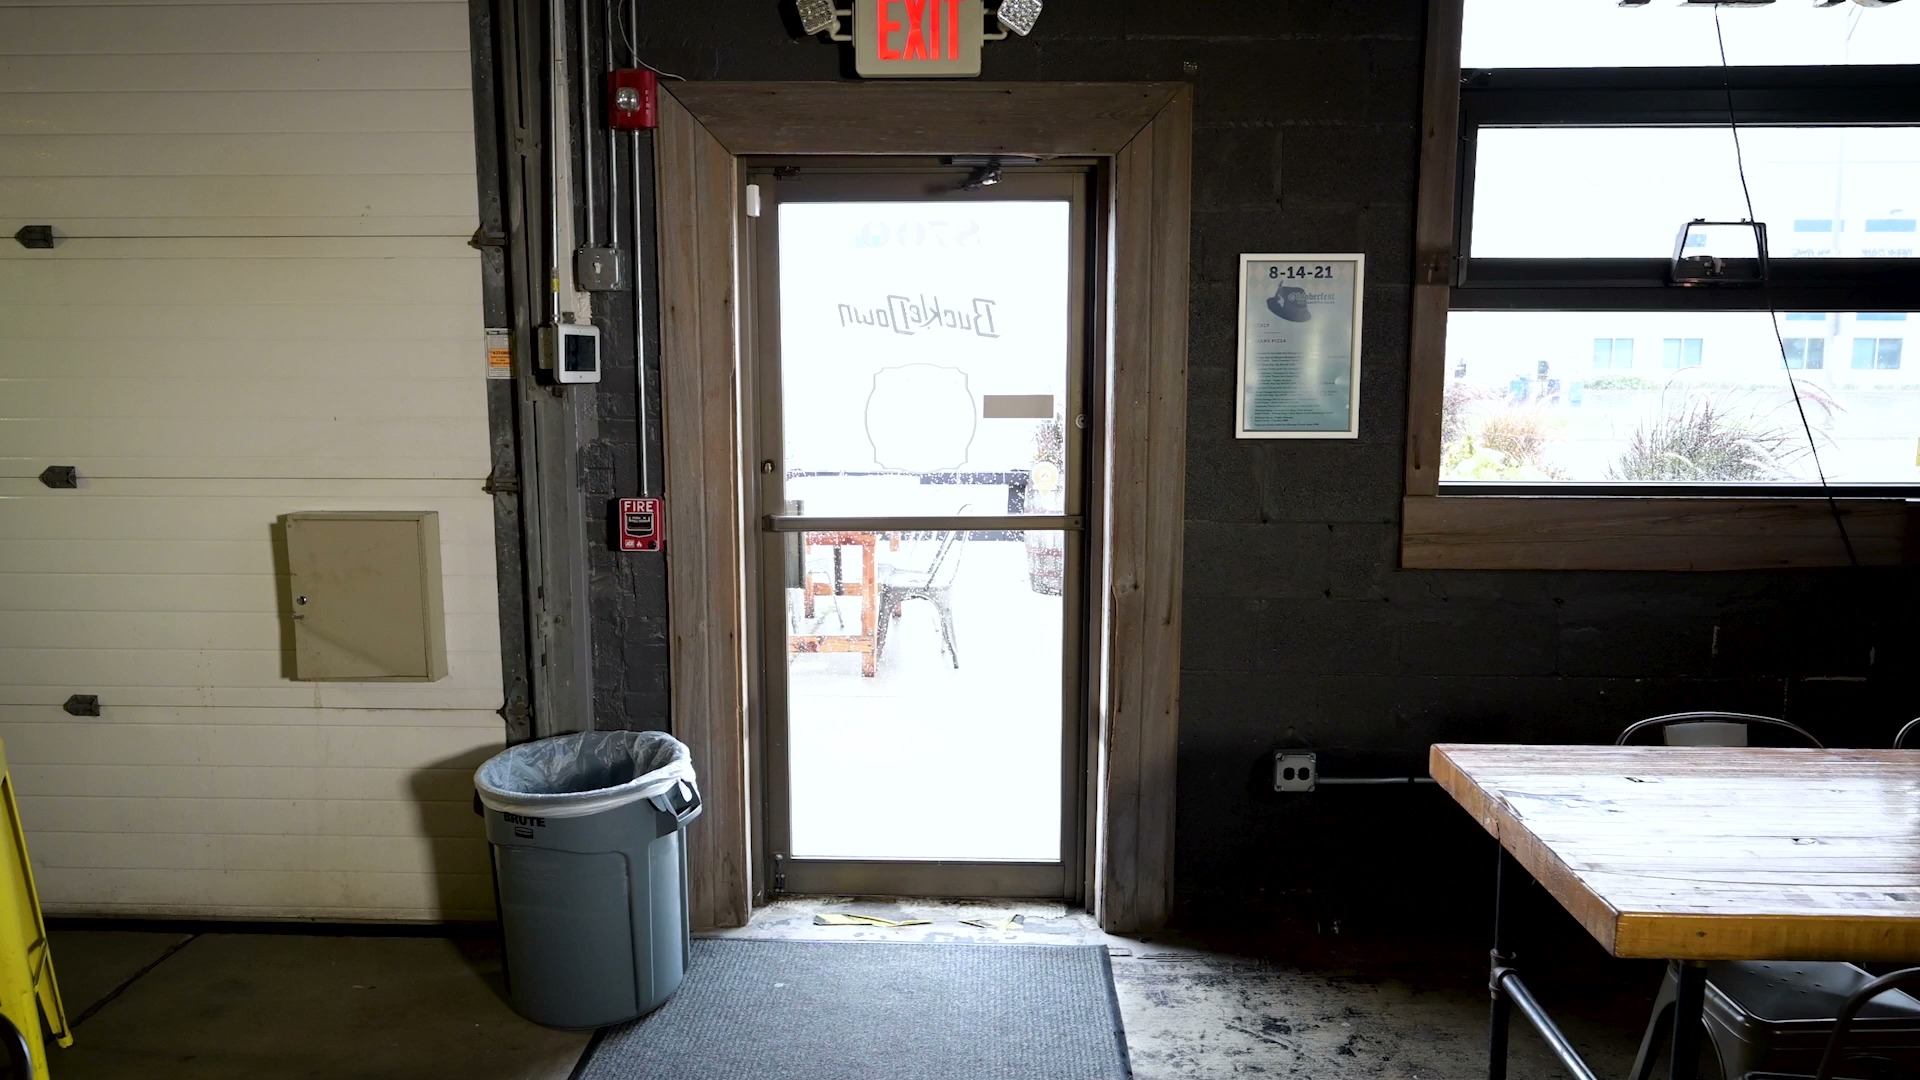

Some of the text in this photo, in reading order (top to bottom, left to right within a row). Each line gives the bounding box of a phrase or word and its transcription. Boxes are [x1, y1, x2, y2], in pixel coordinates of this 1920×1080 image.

[877, 0, 964, 60] EXIT
[1269, 266, 1333, 279] 8-14-21
[624, 501, 654, 512] FIRE
[503, 811, 546, 828] BRUTE
